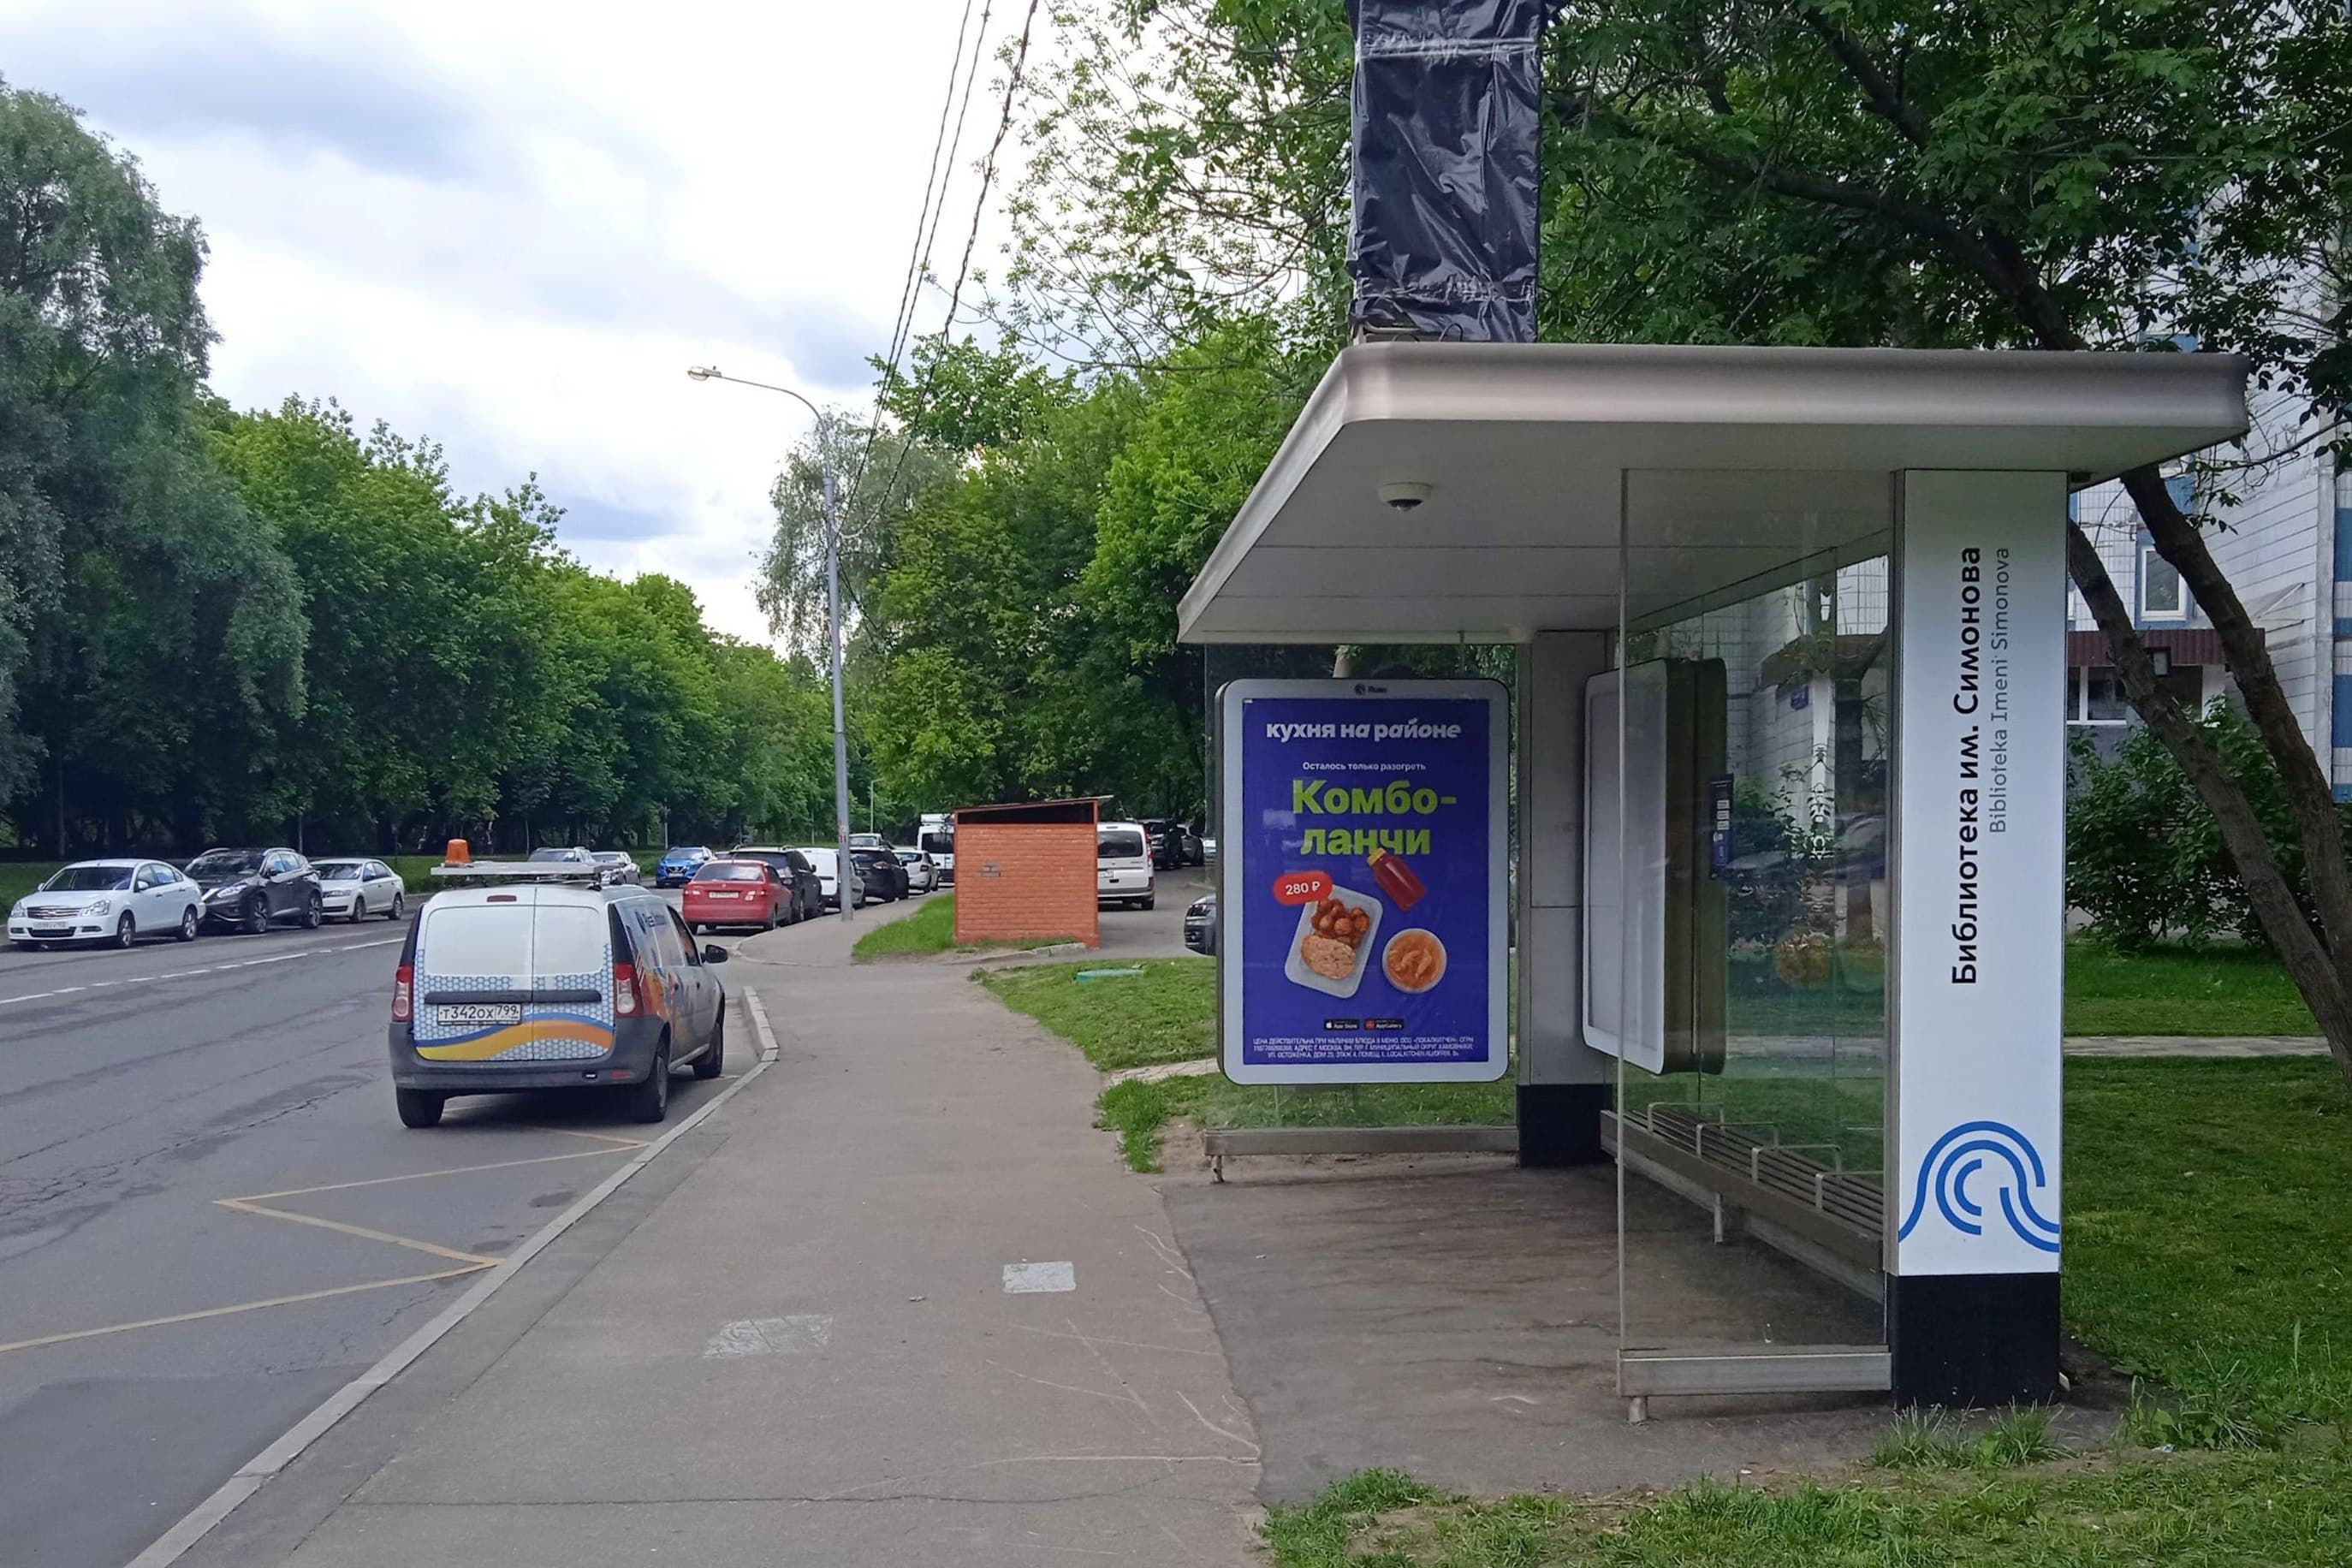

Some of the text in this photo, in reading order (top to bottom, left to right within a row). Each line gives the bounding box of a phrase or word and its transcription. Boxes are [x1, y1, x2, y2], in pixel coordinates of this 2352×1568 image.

[1990, 547, 2010, 834] Biblioteka Imeni Simonova
[1266, 718, 1462, 743] кухня на районе
[1303, 761, 1426, 773] Осталось только разогреть
[1951, 547, 1981, 984] Библиотека им. Симонова
[1292, 780, 1458, 814] Комбо-
[1300, 829, 1430, 855] ланчи
[1286, 882, 1310, 895] 280
[443, 1005, 518, 1019] Т342ОХ 799
